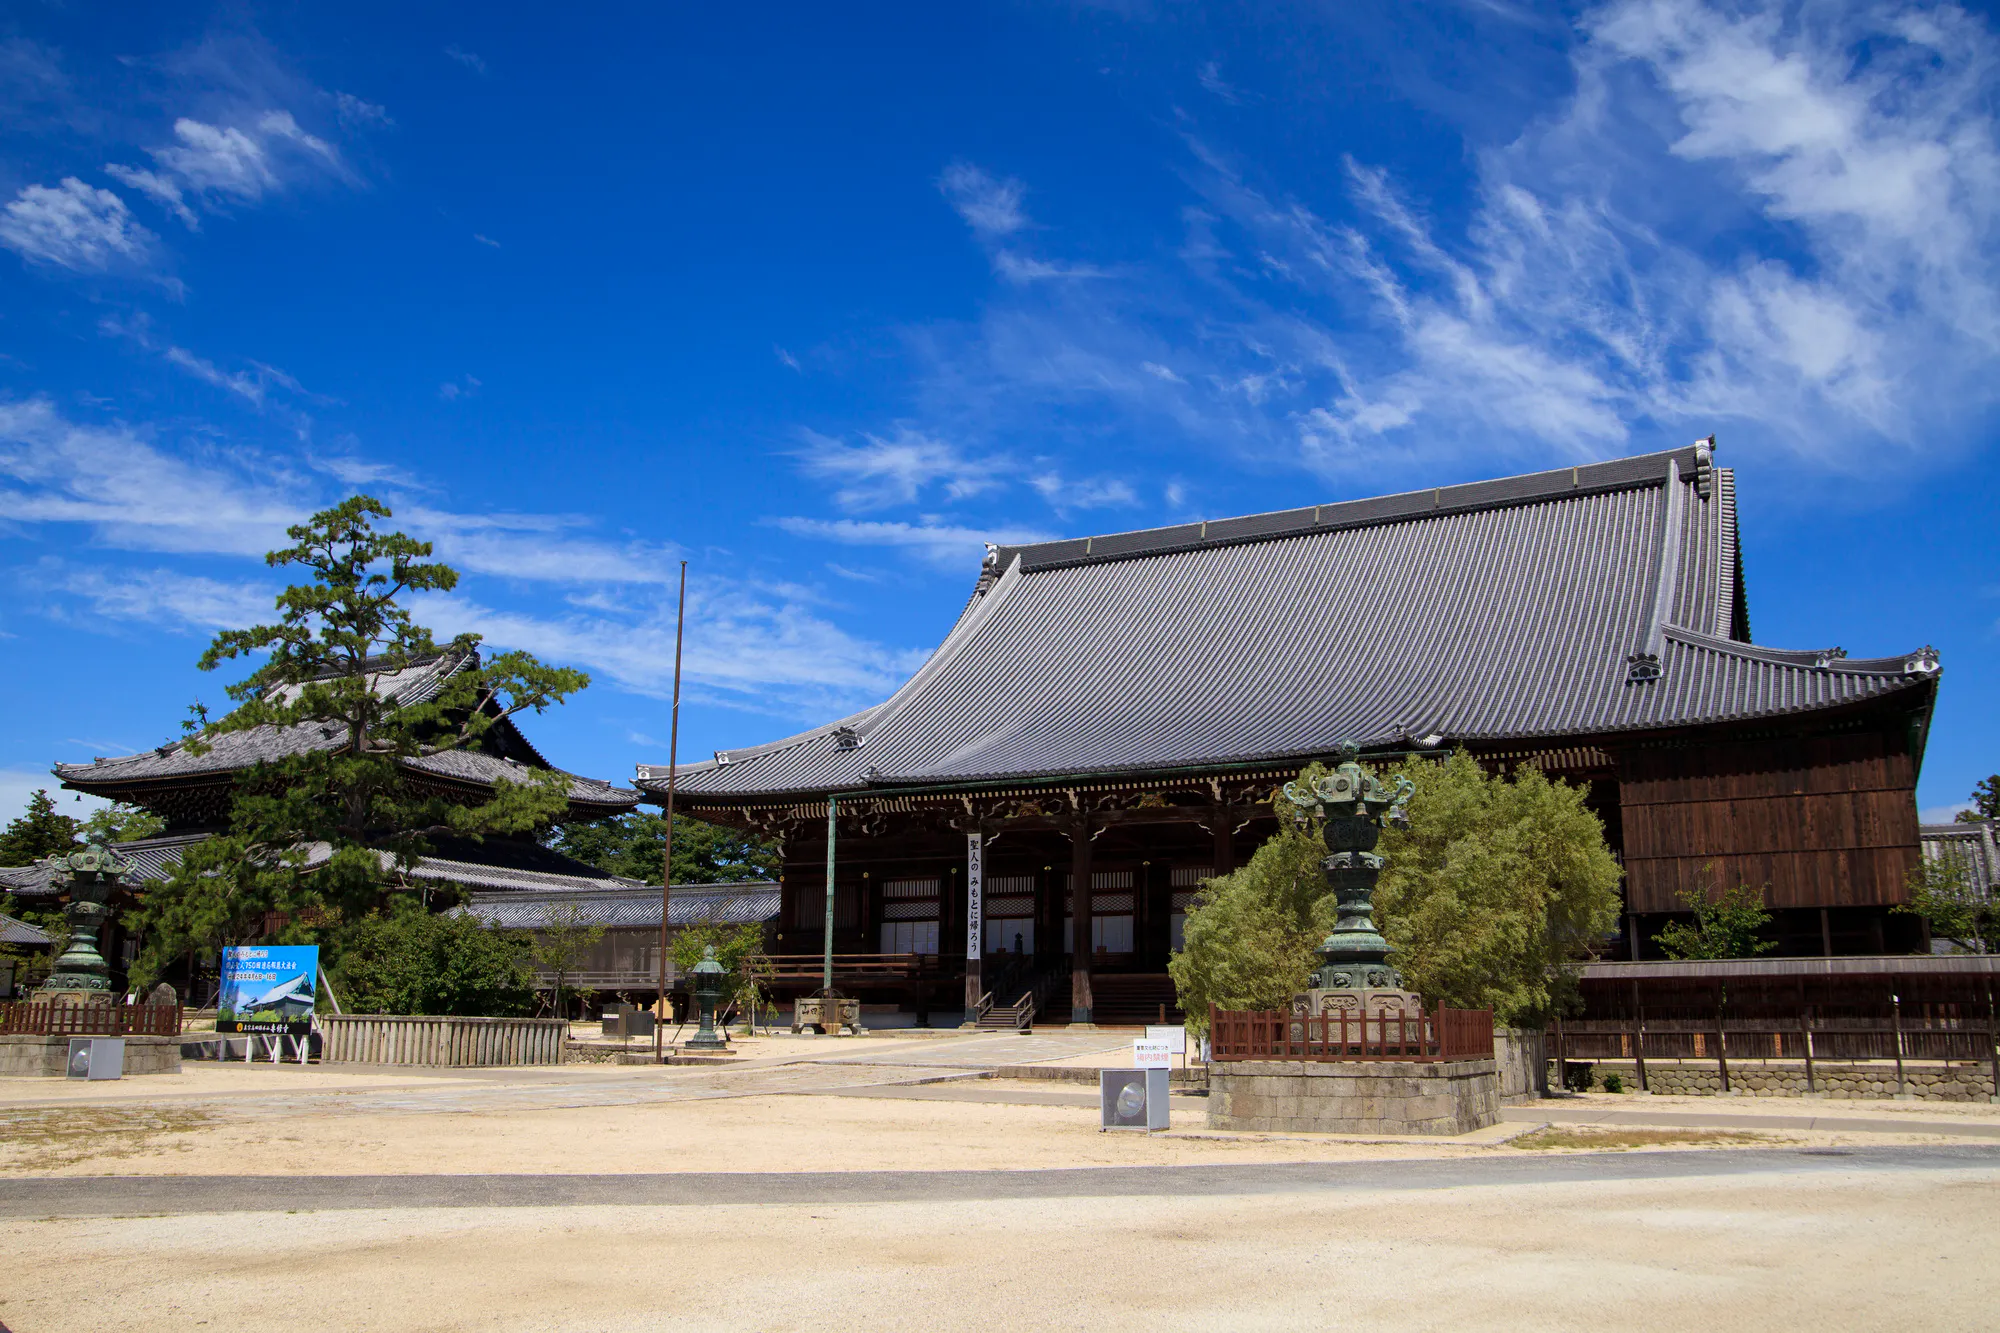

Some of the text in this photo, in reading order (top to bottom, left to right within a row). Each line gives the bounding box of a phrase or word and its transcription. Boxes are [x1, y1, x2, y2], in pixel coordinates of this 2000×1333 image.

[970, 839, 979, 952] 聖人のみもとに帰ろう
